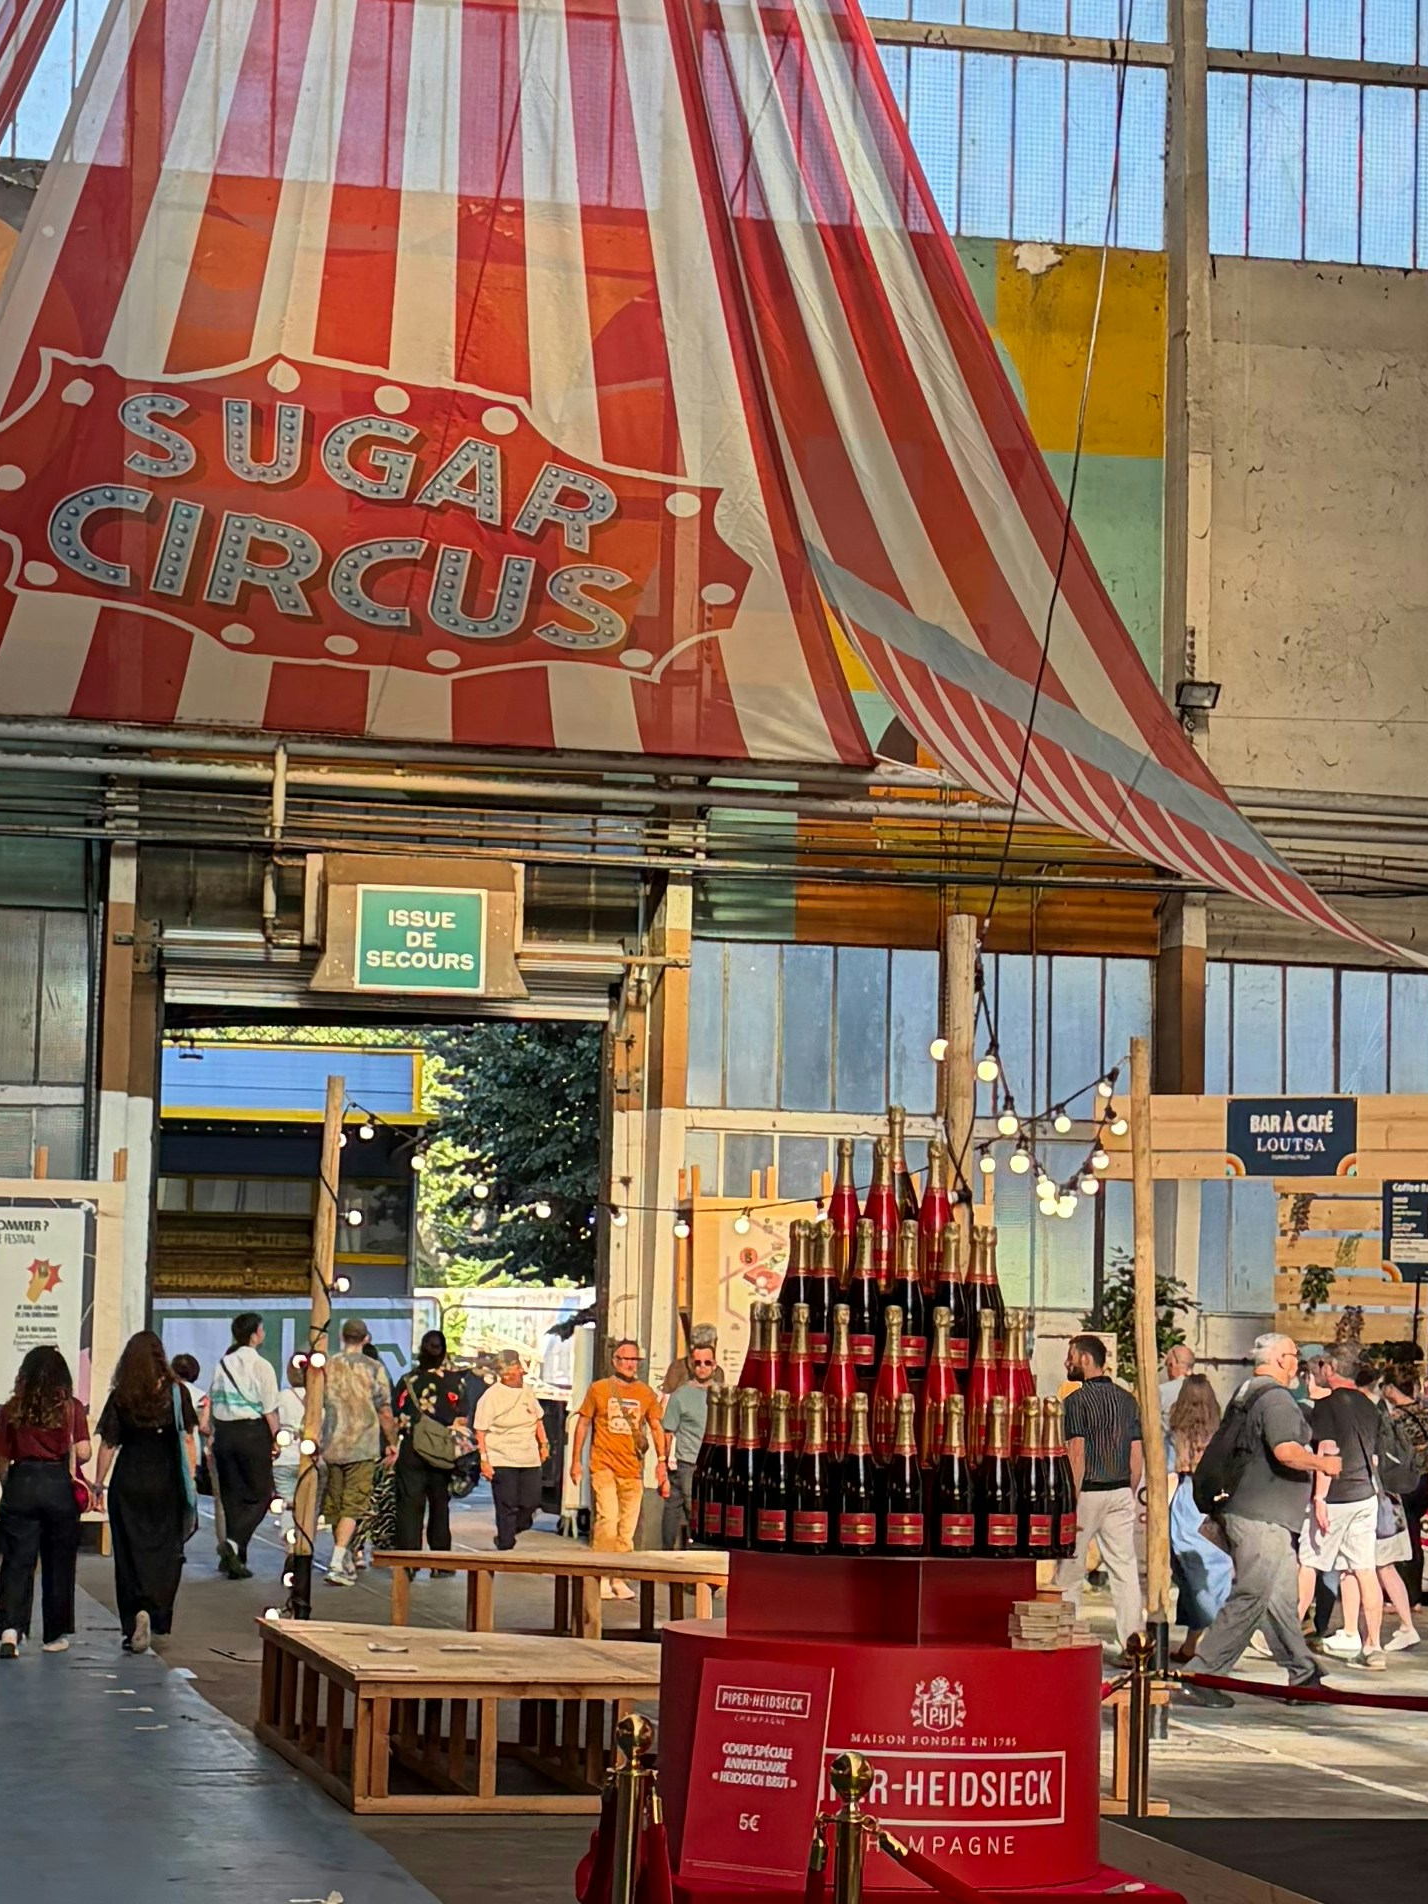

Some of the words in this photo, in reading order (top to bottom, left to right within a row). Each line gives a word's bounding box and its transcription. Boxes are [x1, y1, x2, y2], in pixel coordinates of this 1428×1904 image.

[118, 391, 620, 556] SUGAR
[48, 483, 634, 651] CIRCUS
[388, 908, 457, 929] ISSUE
[405, 930, 438, 949] DE
[365, 949, 475, 971] SECOURS
[1249, 1114, 1281, 1134] BAR
[1283, 1109, 1295, 1134] À
[1296, 1109, 1334, 1134] CAFÉ
[1256, 1137, 1326, 1153] LOUTSA
[721, 1692, 804, 1712] PIPER-HEIDSIECK
[734, 1714, 786, 1726] CHAMPAGNE
[850, 1733, 906, 1744] MAISON
[912, 1734, 967, 1746] FONDÉE
[971, 1736, 988, 1747] EN
[722, 1742, 753, 1757] COUPE
[754, 1743, 793, 1760] SPÉCIALE
[724, 1757, 788, 1774] ANNIVERSAIRE
[765, 1775, 789, 1789] BRUT
[738, 1813, 761, 1832] 5€
[865, 1834, 1015, 1856] HMPAGNE
